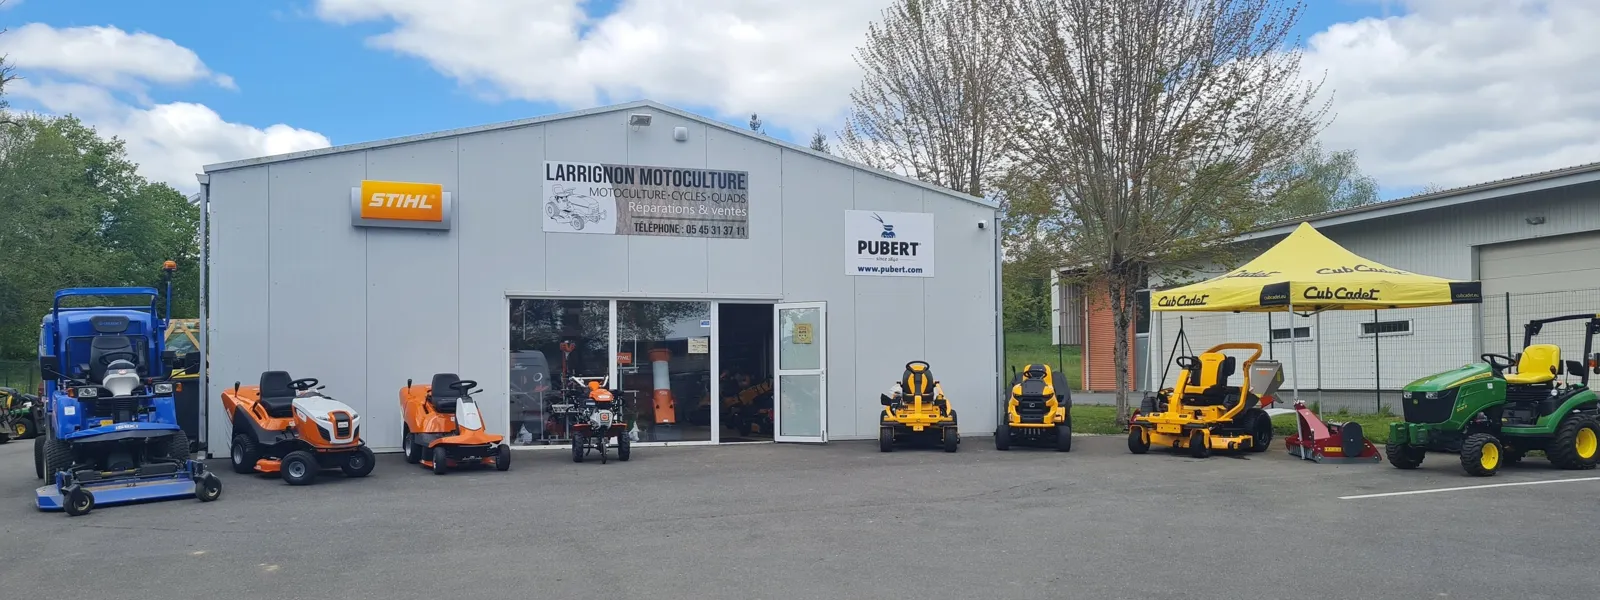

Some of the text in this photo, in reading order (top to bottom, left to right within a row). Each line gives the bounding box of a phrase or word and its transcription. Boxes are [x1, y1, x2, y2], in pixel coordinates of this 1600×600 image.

[546, 163, 746, 190] LARRIGNON MOTOCULTURE
[368, 192, 433, 209] STIHL
[589, 187, 746, 204] MOTOCULTURE CYCLES QUADS
[628, 202, 747, 217] Réparations & ventes
[634, 221, 680, 234] TÉLÉPHONE
[686, 224, 697, 234] 05
[698, 225, 709, 235] 45
[711, 225, 721, 236] 31
[723, 226, 734, 236] 37
[736, 227, 746, 236] 11
[857, 240, 919, 256] PUBERT
[857, 265, 923, 274] www.pubert.com
[1316, 266, 1354, 275] Cub
[1157, 294, 1209, 307] Cub Cadet
[1303, 286, 1381, 300] Cub Cadet
